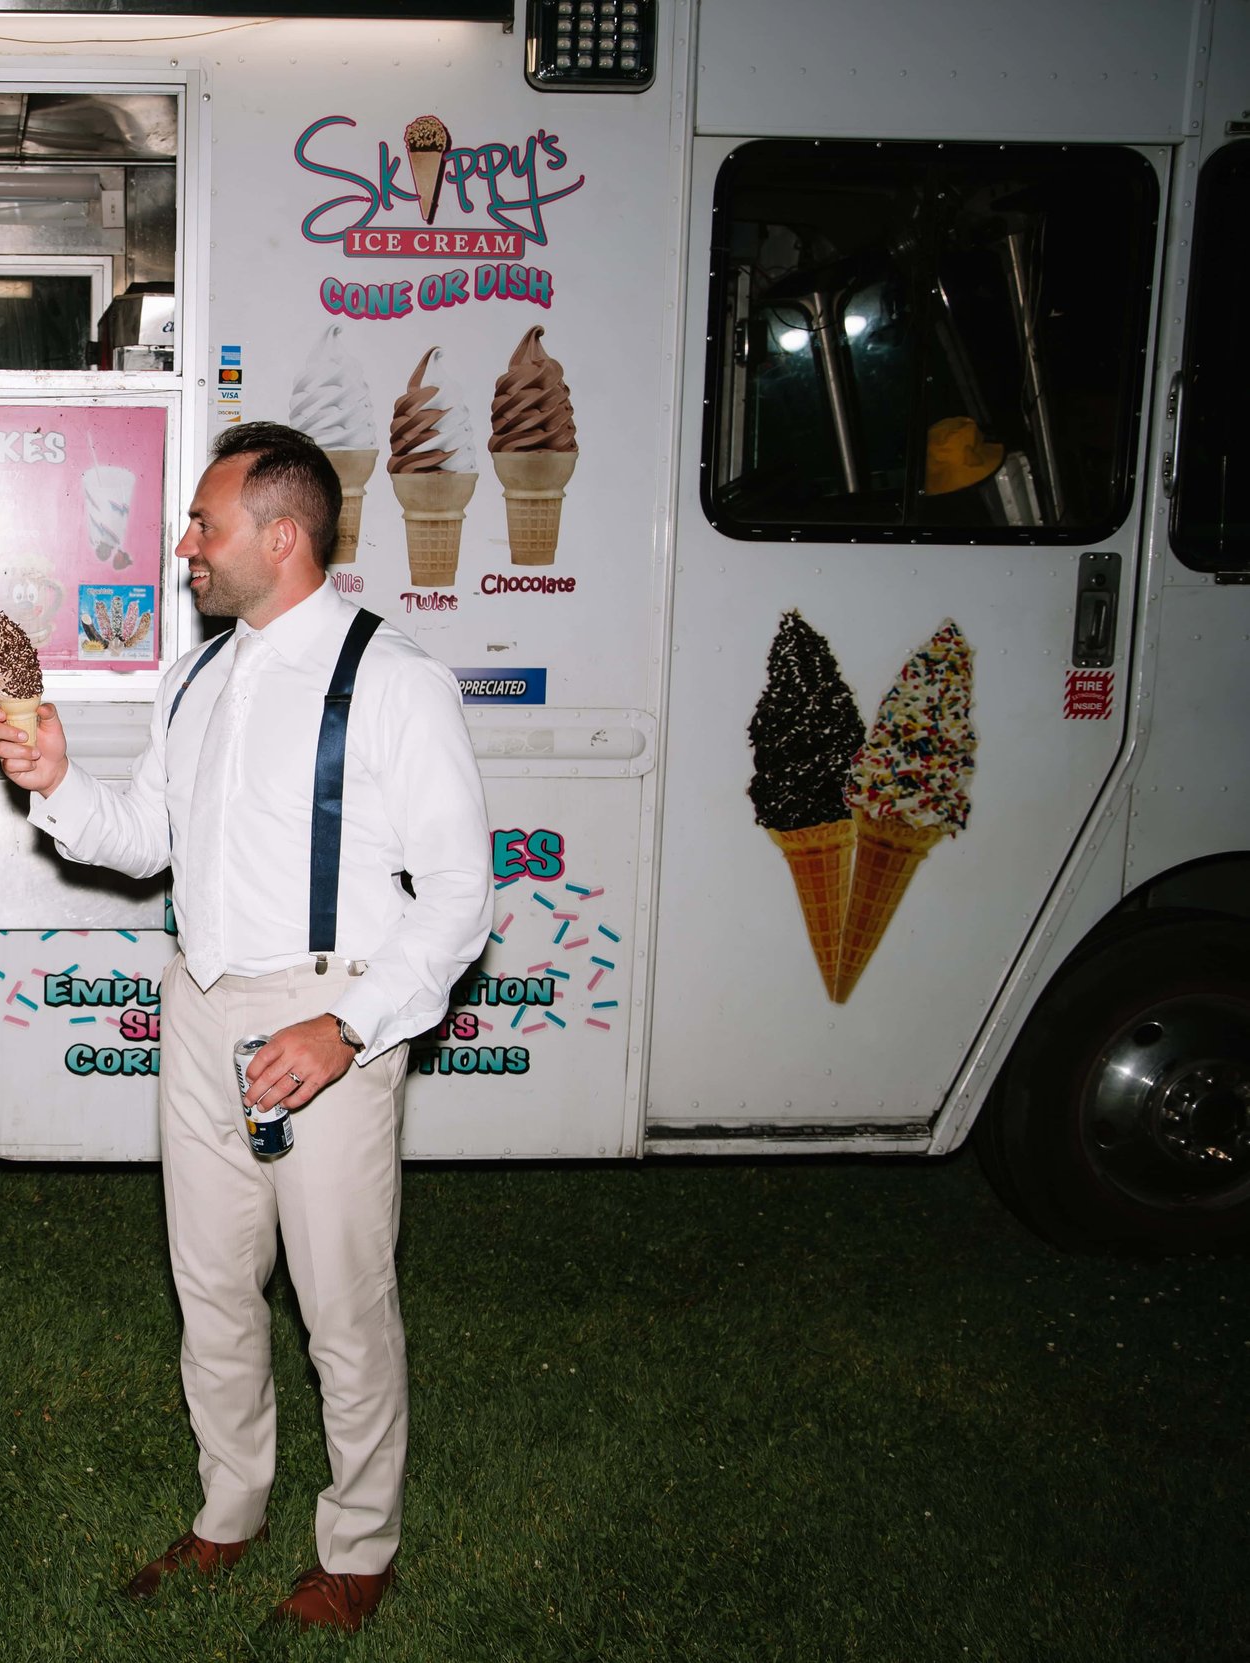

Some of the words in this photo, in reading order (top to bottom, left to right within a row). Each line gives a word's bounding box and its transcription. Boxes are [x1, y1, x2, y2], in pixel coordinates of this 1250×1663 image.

[352, 233, 402, 252] ICE
[413, 234, 516, 253] CREAM
[320, 276, 414, 321] CONE
[418, 268, 470, 311] OR
[474, 263, 553, 309] DISH
[481, 574, 576, 595] Chocolate
[400, 592, 458, 613] Twist
[1076, 681, 1103, 691] FIRE
[45, 974, 161, 1007] EMPL
